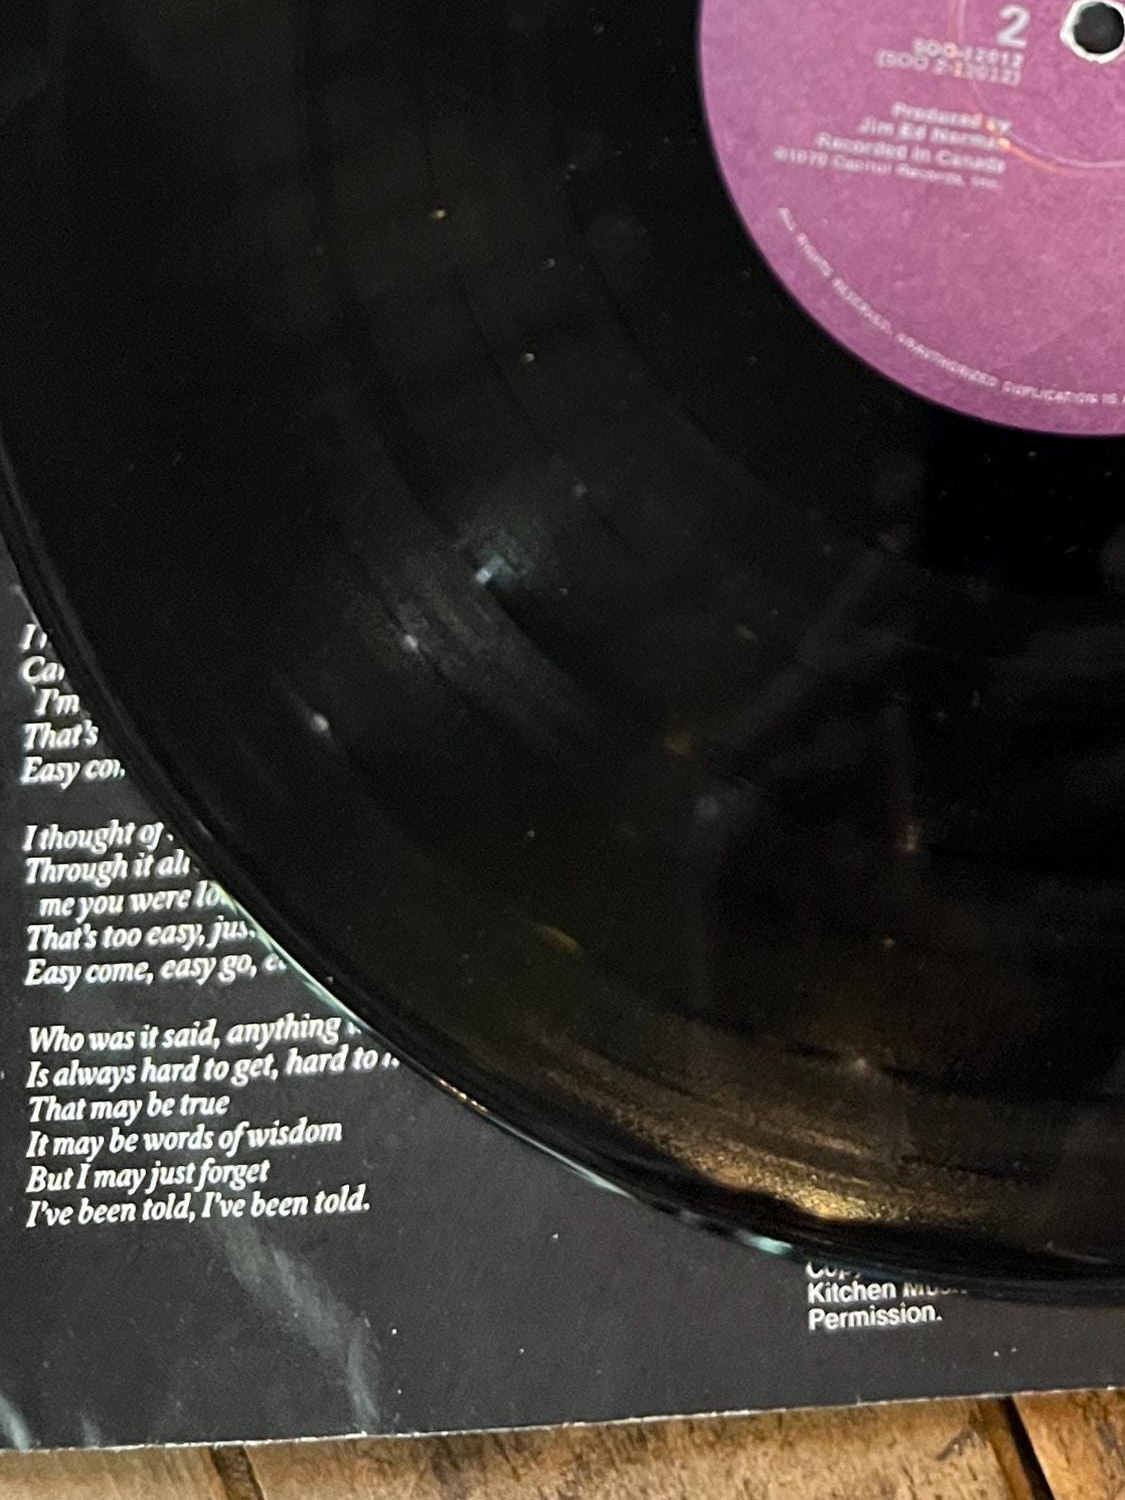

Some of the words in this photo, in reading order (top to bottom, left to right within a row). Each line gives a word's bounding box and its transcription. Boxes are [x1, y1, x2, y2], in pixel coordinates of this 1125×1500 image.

[996, 4, 1030, 48] 2
[34, 688, 80, 715] I'm
[23, 719, 99, 750] That's
[20, 756, 81, 790] Easy
[22, 825, 38, 850] I
[39, 819, 136, 854] thought
[25, 853, 128, 888] Through
[133, 853, 153, 877] it
[39, 896, 74, 917] me
[75, 895, 124, 924] you
[128, 889, 192, 913] were
[27, 923, 98, 951] That's
[102, 925, 141, 948] too
[147, 922, 205, 951] easy,
[206, 915, 256, 949] jus
[24, 958, 81, 992] Easy
[85, 961, 153, 985] come,
[160, 957, 216, 985] easy
[217, 953, 257, 982] go,
[29, 1025, 85, 1052] Who
[88, 1031, 135, 1050] was
[140, 1024, 159, 1049] it
[161, 1018, 220, 1050] said,
[226, 1012, 341, 1051] anything
[26, 1061, 50, 1088] Is
[53, 1059, 136, 1092] always
[141, 1054, 199, 1082] hard
[203, 1057, 229, 1081] to
[230, 1053, 279, 1087] get,
[286, 1044, 348, 1075] hard
[352, 1047, 378, 1070] to
[29, 1095, 87, 1122] That
[90, 1100, 143, 1126] may
[147, 1090, 175, 1117] be
[180, 1094, 230, 1116] true
[25, 1131, 49, 1158] It
[53, 1136, 104, 1162] may
[109, 1127, 139, 1153] be
[142, 1123, 214, 1151] words
[218, 1121, 250, 1158] of
[247, 1117, 342, 1148] wisdom
[26, 1165, 74, 1193] But
[76, 1163, 91, 1189] I
[93, 1167, 146, 1195] may
[145, 1160, 196, 1194] just
[193, 1157, 271, 1192] forget
[26, 1200, 74, 1227] I've
[78, 1197, 136, 1225] been
[142, 1193, 196, 1223] told,
[202, 1191, 246, 1218] I've
[250, 1190, 309, 1217] been
[314, 1183, 370, 1214] told.
[808, 1280, 897, 1304] Kitchen
[808, 1302, 943, 1331] Permission.
